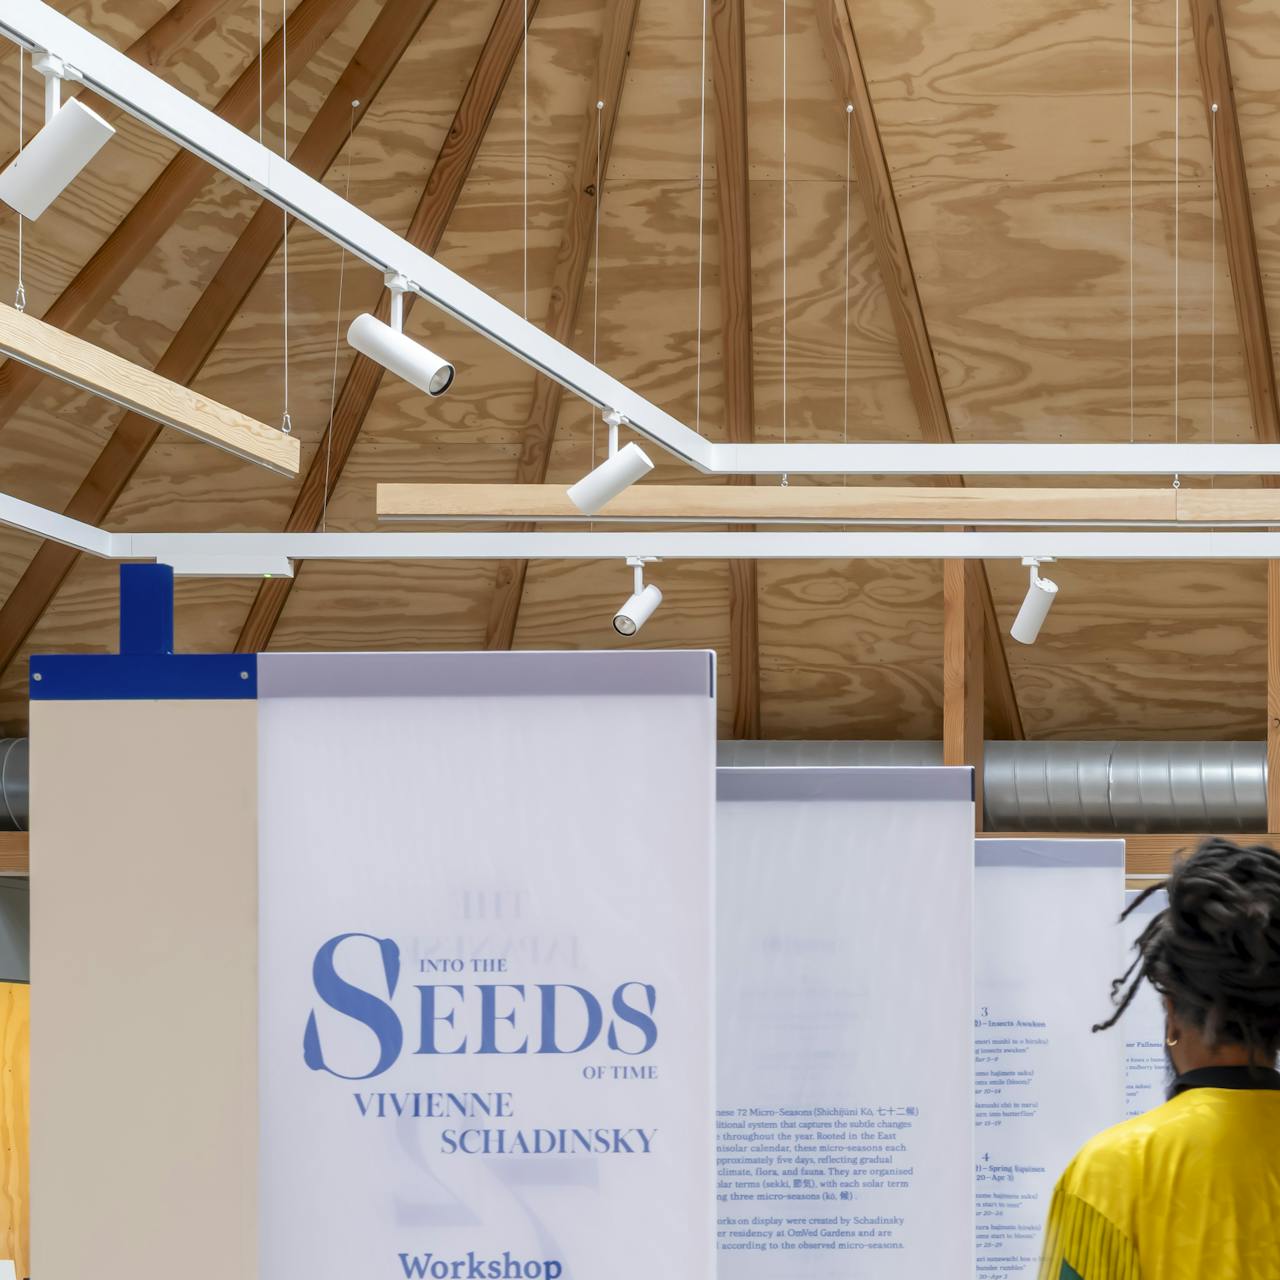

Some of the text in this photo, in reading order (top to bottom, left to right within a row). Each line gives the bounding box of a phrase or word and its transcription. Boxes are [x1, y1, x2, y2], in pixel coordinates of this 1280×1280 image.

[420, 958, 508, 973] INTO THE
[303, 932, 658, 1080] SEEDS
[981, 1007, 989, 1017] 3
[582, 1066, 658, 1080] OF TIME
[353, 1092, 514, 1118] VIVIENNE
[750, 1108, 812, 1117] Micro-Seasons
[748, 1121, 777, 1130] system
[780, 1120, 796, 1129] that
[834, 1120, 847, 1128] the
[850, 1120, 875, 1128] subtle
[877, 1120, 911, 1130] changes
[440, 1128, 658, 1154] SCHADINSKY
[723, 1132, 774, 1142] throughout
[777, 1132, 791, 1140] the
[817, 1132, 846, 1140] Rooted
[849, 1132, 858, 1140] in
[861, 1132, 875, 1140] the
[877, 1132, 896, 1140] East
[794, 1144, 817, 1152] these
[819, 1144, 882, 1152] micro-seasons
[885, 1144, 906, 1152] each
[717, 1156, 773, 1166] pproximately
[776, 1156, 792, 1164] five
[818, 1155, 858, 1166] reflecting
[859, 1155, 892, 1165] gradual
[782, 1168, 798, 1176] and
[828, 1168, 850, 1177] They
[820, 1179, 837, 1188] with
[840, 1179, 859, 1188] each
[862, 1179, 884, 1188] solar
[887, 1180, 909, 1188] term
[730, 1192, 754, 1200] three
[757, 1192, 820, 1200] micro-seasons
[751, 1217, 784, 1227] display
[840, 1217, 850, 1226] by
[853, 1217, 904, 1226] Schadinsky
[729, 1229, 772, 1239] residency
[776, 1229, 784, 1237] at
[820, 1229, 856, 1237] Gardens
[858, 1229, 875, 1237] and
[721, 1241, 904, 1251] according to the observed micro-seasons.
